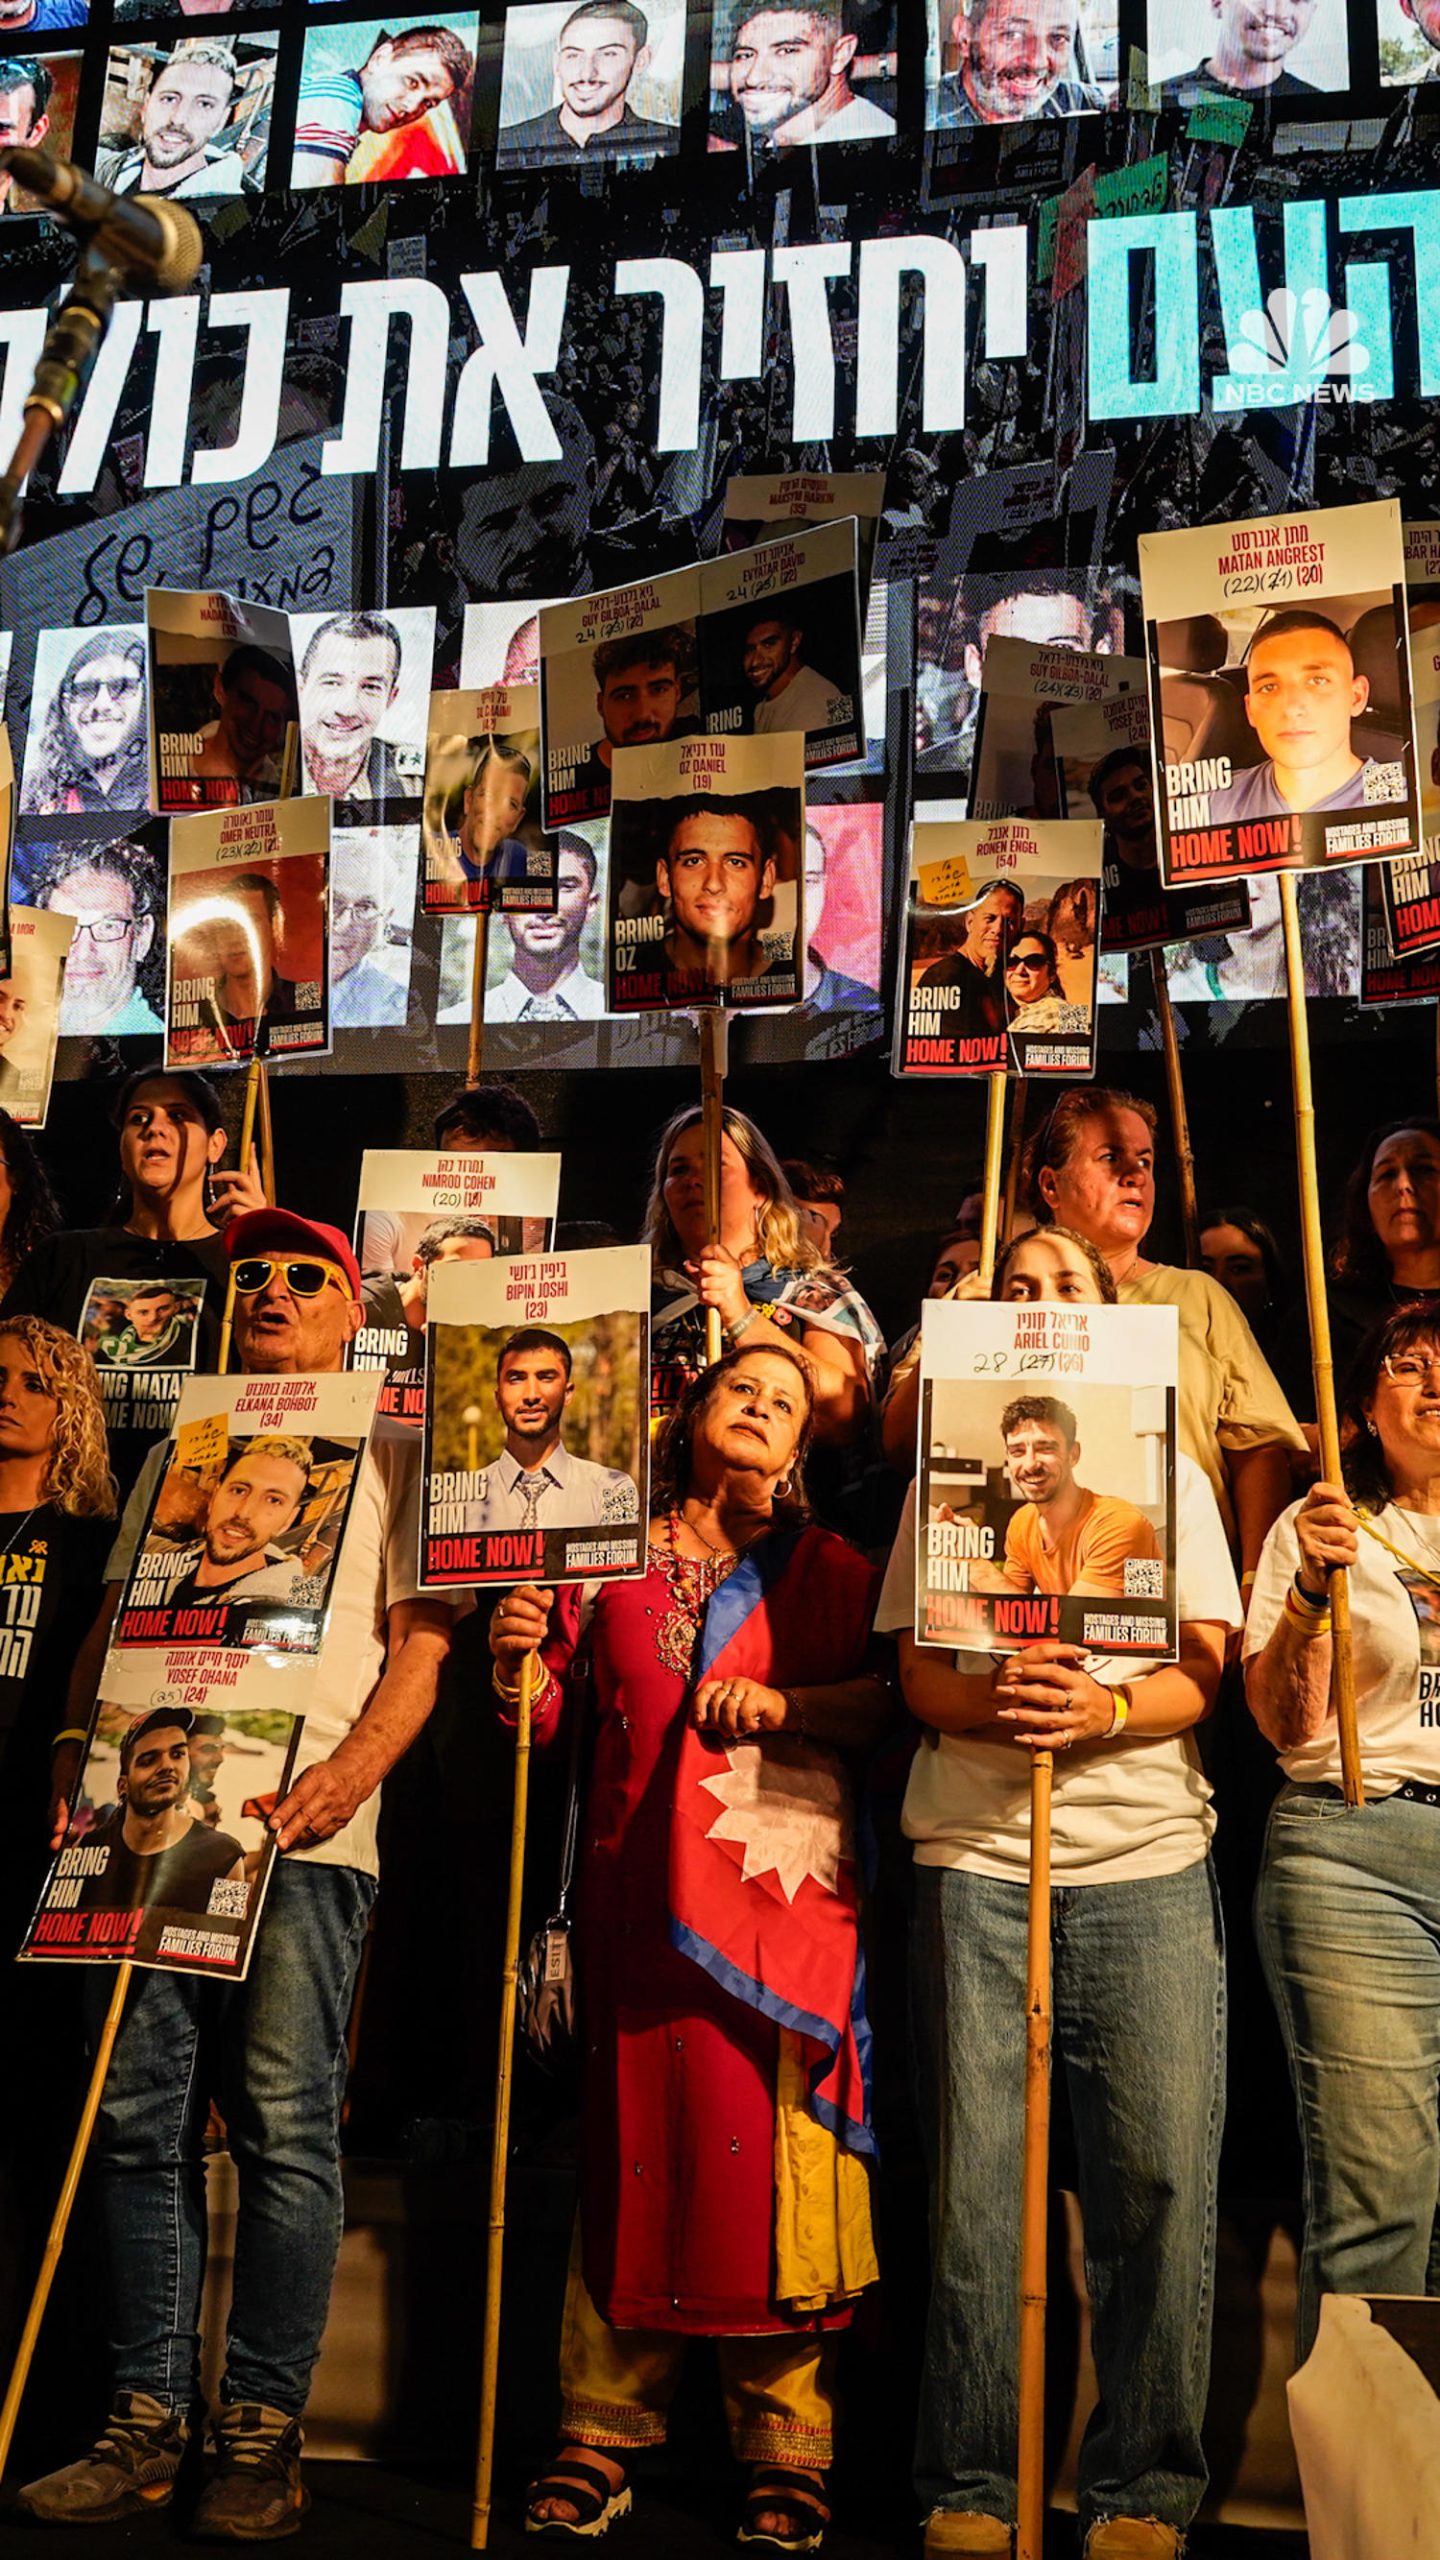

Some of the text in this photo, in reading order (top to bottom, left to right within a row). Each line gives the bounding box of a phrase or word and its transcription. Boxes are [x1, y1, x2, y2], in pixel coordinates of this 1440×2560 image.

[614, 224, 1028, 453] יחזיר
[321, 265, 570, 475] את
[1232, 524, 1309, 552] מתן אנגרסט
[743, 552, 806, 582] EVYATAR DAVID
[1218, 542, 1325, 576] MATAN ANGREST
[726, 584, 748, 601] 24
[582, 598, 661, 627] GUY GILBOA-DALAL
[576, 628, 596, 643] 24
[1030, 663, 1047, 678] GUY
[160, 733, 204, 756] BRING
[681, 743, 726, 759] עוז דניאל
[161, 756, 189, 777] HIM
[549, 743, 591, 771] BRING
[680, 758, 726, 773] OZ DANIEL
[549, 768, 576, 793] HIM
[693, 774, 711, 790] (19)
[1166, 756, 1232, 798] BRING
[549, 790, 588, 816] HOME
[1168, 796, 1211, 831] HIM
[220, 824, 277, 844] OMER NEUTRA
[1012, 826, 1030, 839] רונן
[1170, 814, 1304, 868] HOME NOW!
[1325, 827, 1410, 855] FAMILIES FORUM
[977, 840, 1039, 856] RONEN ENGEL
[996, 854, 1017, 869] (54)
[1393, 868, 1431, 905] HIM
[615, 915, 665, 945] BRING
[1396, 898, 1440, 938] HOM
[615, 946, 637, 972] OZ
[174, 977, 215, 1003] BRING
[615, 976, 662, 999] HOME
[732, 982, 796, 998] FAMILIES FORUM
[1366, 972, 1408, 993] HOME
[909, 985, 961, 1011] BRING
[171, 1003, 199, 1028] HIM
[908, 1012, 942, 1036] HIM
[906, 1033, 1008, 1063] HOME NOW!
[1025, 1053, 1090, 1067] FAMILIES FORUM
[437, 1159, 484, 1173] נמרוד כהן
[422, 1174, 496, 1190] NIMROD COHEN
[432, 1191, 462, 1208] (20)
[540, 1261, 566, 1280] ביפין
[506, 1280, 568, 1301] BIPIN JOSHI
[525, 1301, 548, 1320] (23)
[1016, 1311, 1088, 1332] אריאל קוניו
[354, 1327, 408, 1357] BRING
[1013, 1332, 1048, 1350] ARIEL
[973, 1351, 1009, 1374] 28
[282, 1381, 317, 1396] אלקנה
[235, 1397, 319, 1412] ELKANA BOHBOT
[260, 1412, 284, 1429] (34)
[429, 1471, 489, 1502] BRING
[429, 1504, 467, 1534] HIM
[429, 1530, 545, 1571] HOME NOW!
[927, 1525, 995, 1560] BRING
[136, 1552, 192, 1579] BRING
[566, 1550, 637, 1569] FAMILIES FORUM
[927, 1560, 970, 1592] HIM
[127, 1579, 166, 1607] HIM
[2, 1585, 42, 1628] עד
[925, 1595, 1060, 1635] HOME NOW!
[120, 1606, 229, 1638] HOME NOW!
[1084, 1613, 1167, 1628] HOSTAGES AND MISSING
[1083, 1624, 1168, 1645] FAMILIES FORUM
[197, 1651, 223, 1667] חיים
[225, 1652, 249, 1669] יוסף
[166, 1668, 238, 1687] YOSEF OHANA
[184, 1686, 208, 1704] (24)
[56, 1846, 110, 1877] BRING
[45, 1879, 85, 1909] HIM
[34, 1908, 144, 1943] HOME NOW!
[162, 1925, 240, 1946] HOSTAGES AND MISSING
[158, 1937, 238, 1962] FAMILIES FORUM
